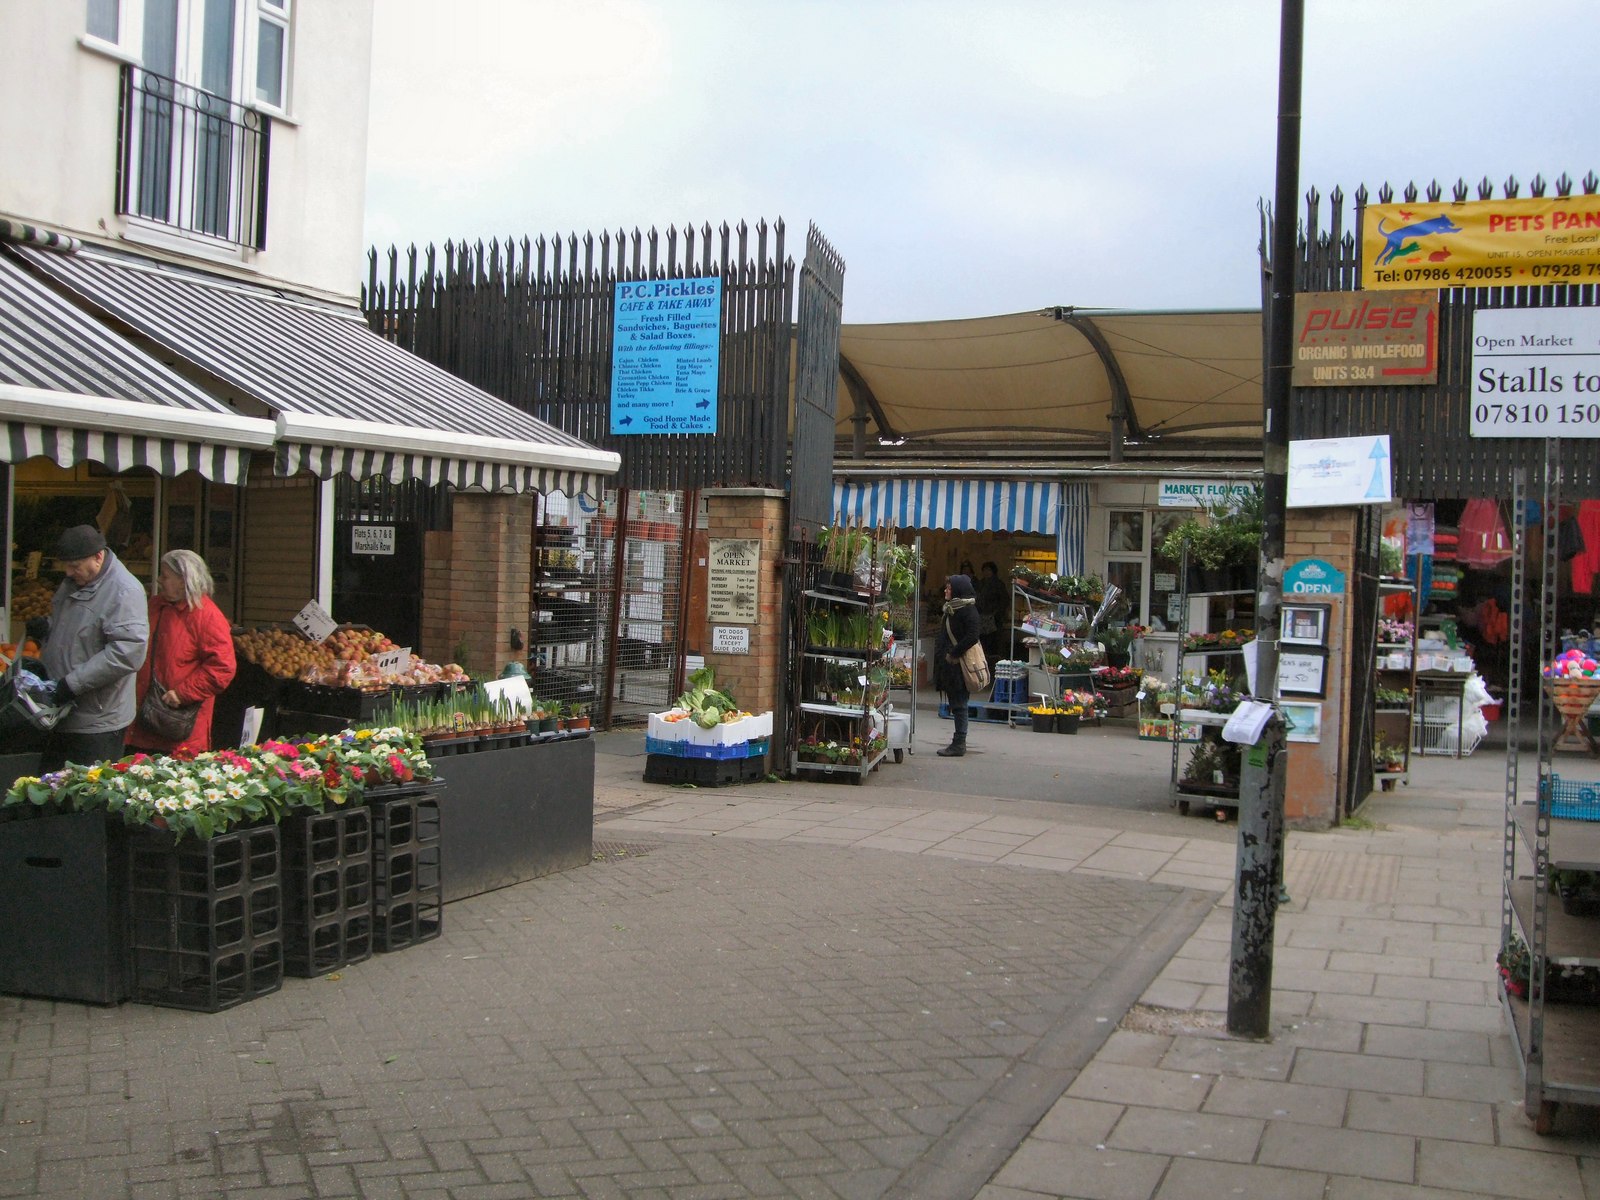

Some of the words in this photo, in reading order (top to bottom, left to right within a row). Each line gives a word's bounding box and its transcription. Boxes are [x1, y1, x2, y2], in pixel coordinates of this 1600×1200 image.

[1489, 214, 1545, 232] PETS
[1544, 235, 1568, 244] Free
[1572, 234, 1598, 243] Local
[1487, 251, 1509, 259] UNIT
[1526, 249, 1552, 258] OPEN
[1374, 270, 1400, 282] Tel:
[1404, 268, 1450, 280] 07986
[1455, 266, 1512, 280] 420055
[1532, 264, 1581, 277] 07928
[654, 282, 715, 298] Pickles
[620, 301, 645, 312] CAFE
[646, 300, 654, 310] &
[658, 300, 684, 310] TAKE
[685, 298, 715, 308] AWAY
[641, 314, 664, 322] Fresh
[667, 313, 691, 321] Filled
[1300, 300, 1418, 343] pulse
[674, 322, 717, 331] Baguettes
[630, 332, 638, 340] &
[1476, 336, 1515, 350] Open
[1520, 335, 1573, 346] Market
[649, 344, 682, 352] following
[1299, 346, 1348, 360] ORGANIC
[1352, 344, 1424, 358] WHOLEFOOD
[1313, 366, 1348, 380] UNITS
[1351, 366, 1374, 380] 3&4
[1478, 366, 1563, 393] Stalls
[1573, 371, 1600, 393] to
[1476, 404, 1548, 424] 07810
[1558, 404, 1600, 423] 150
[1164, 484, 1204, 495] MARKET
[355, 529, 366, 538] Flats
[1293, 581, 1332, 593] OPEN
